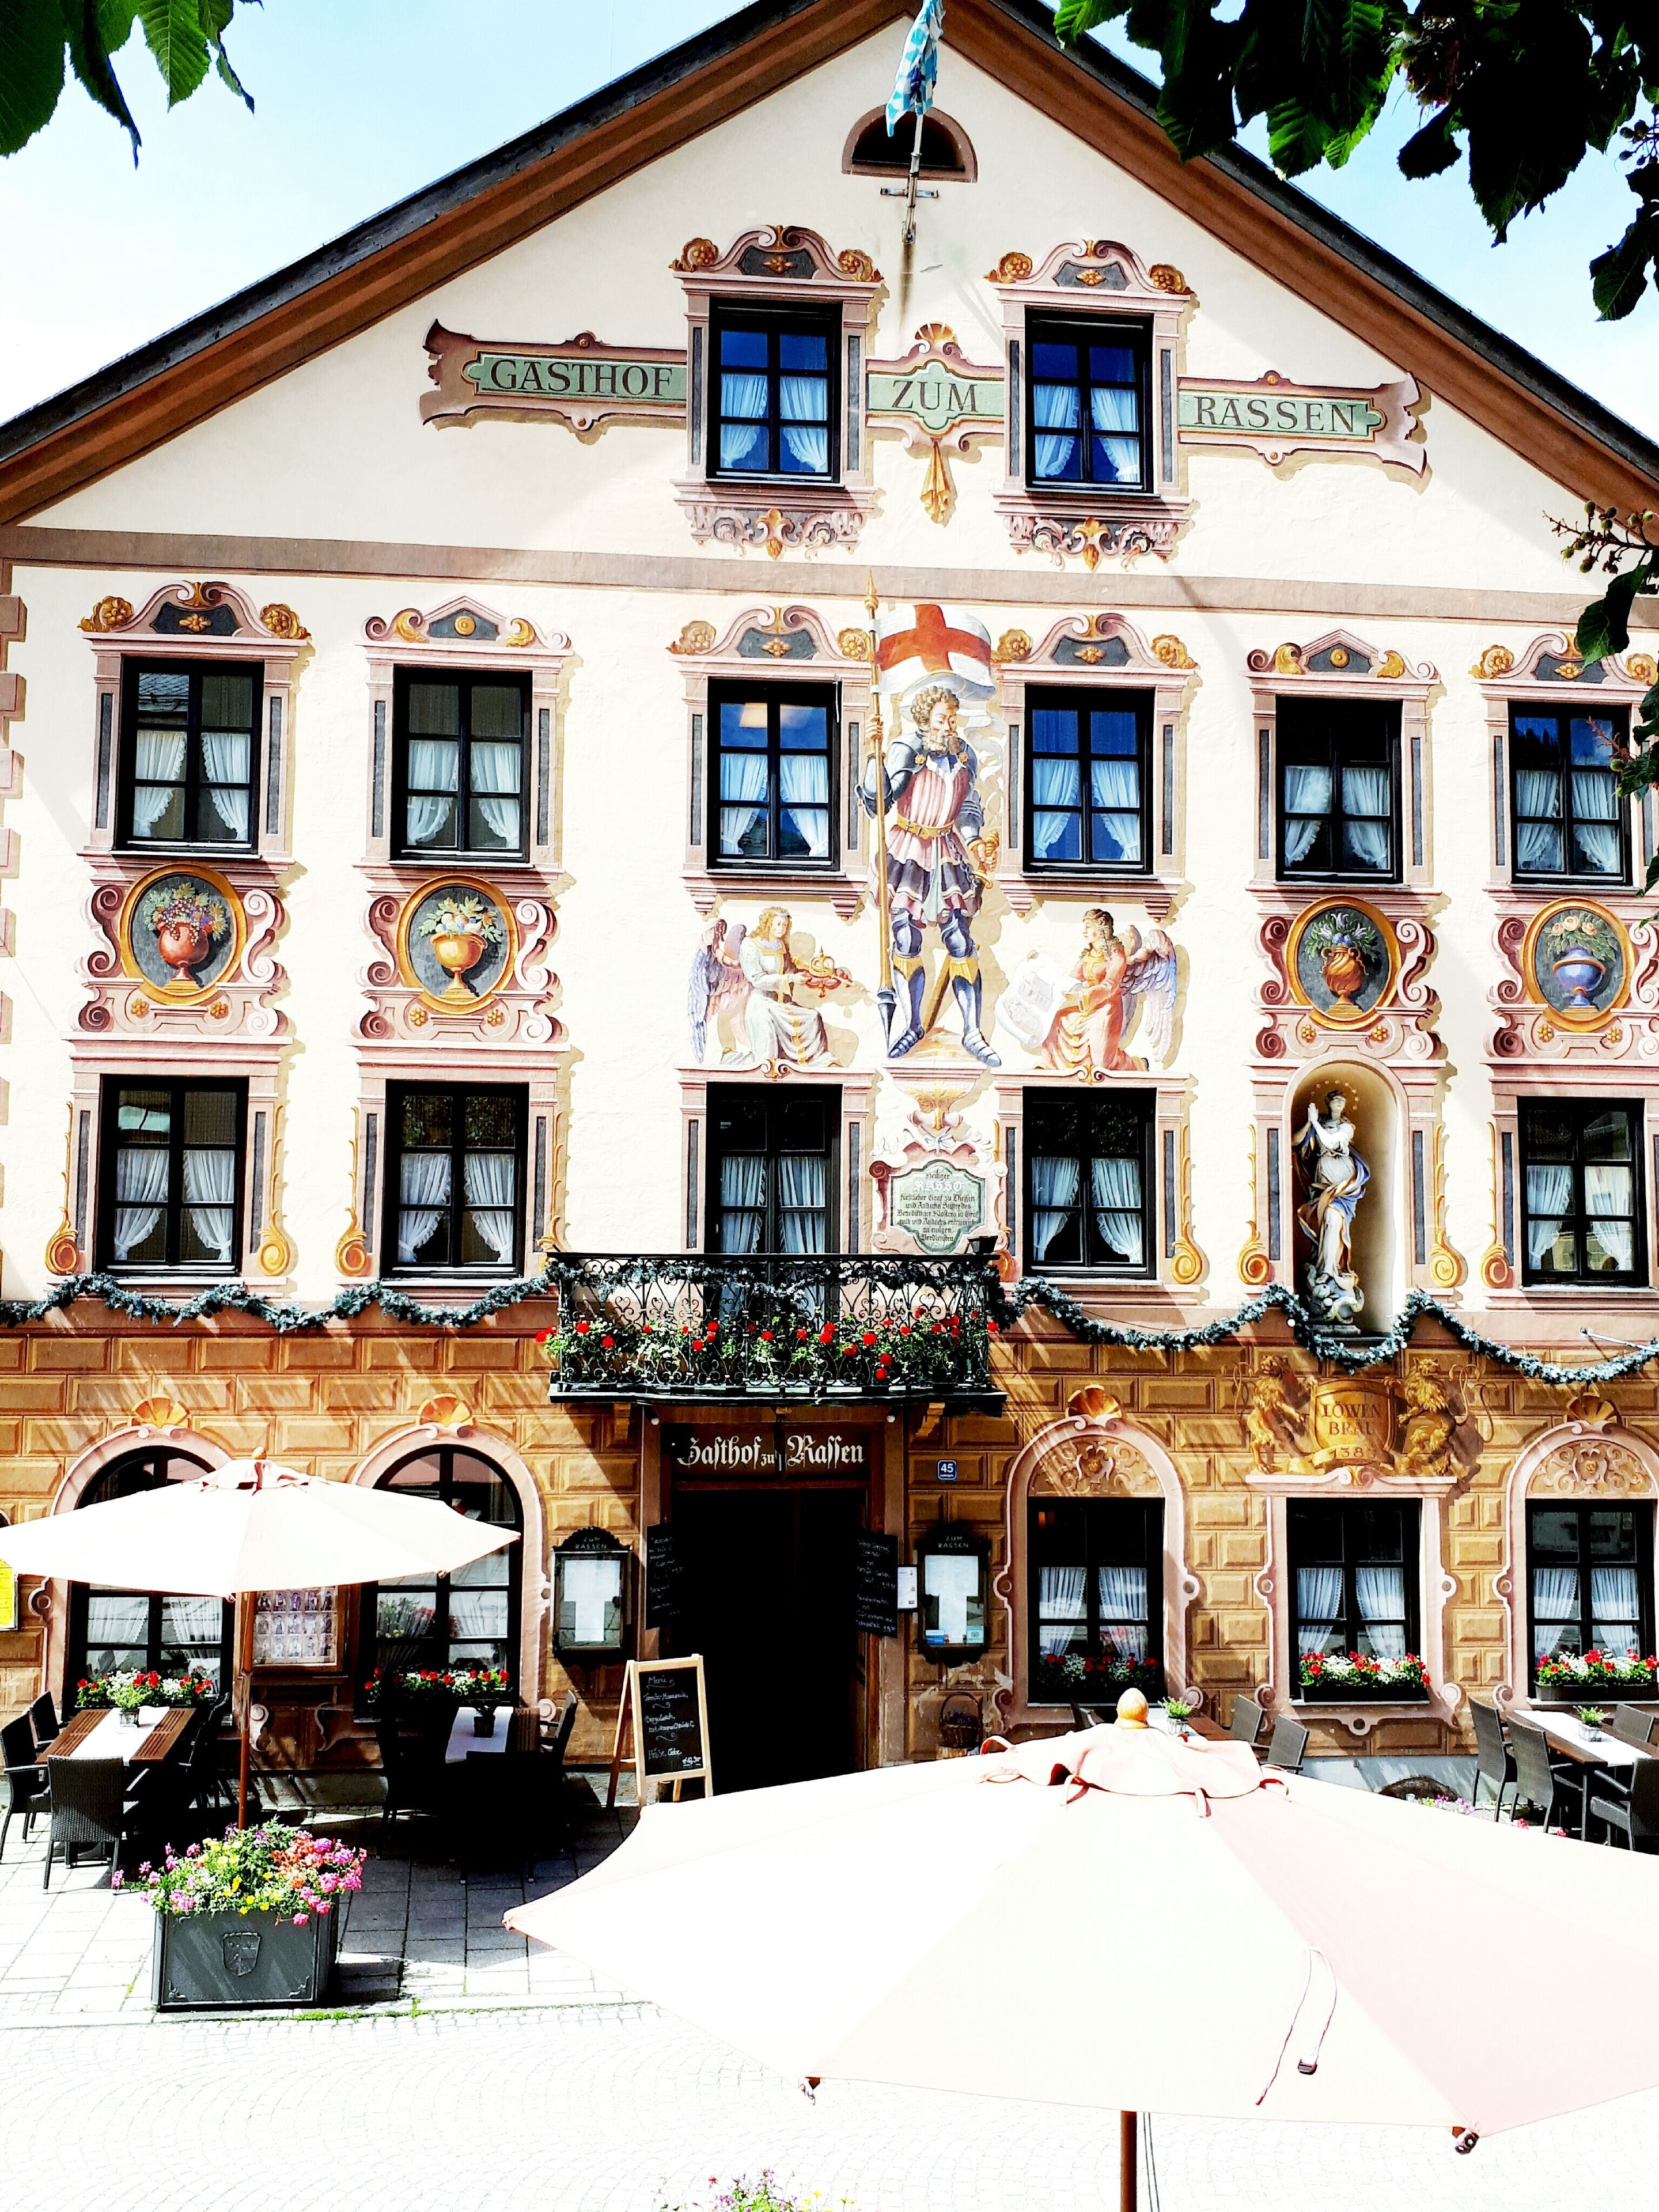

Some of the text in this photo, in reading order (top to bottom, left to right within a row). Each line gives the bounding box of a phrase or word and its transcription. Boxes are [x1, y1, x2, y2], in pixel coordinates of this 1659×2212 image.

[491, 359, 1357, 433] GASTHOF ZUM RASSEN
[925, 1167, 950, 1181] Heiliger
[913, 1180, 962, 1193] RASSO
[1321, 1401, 1381, 1418] LÖWEN
[1329, 1419, 1374, 1435] BRÄU
[941, 1463, 954, 1473] 45
